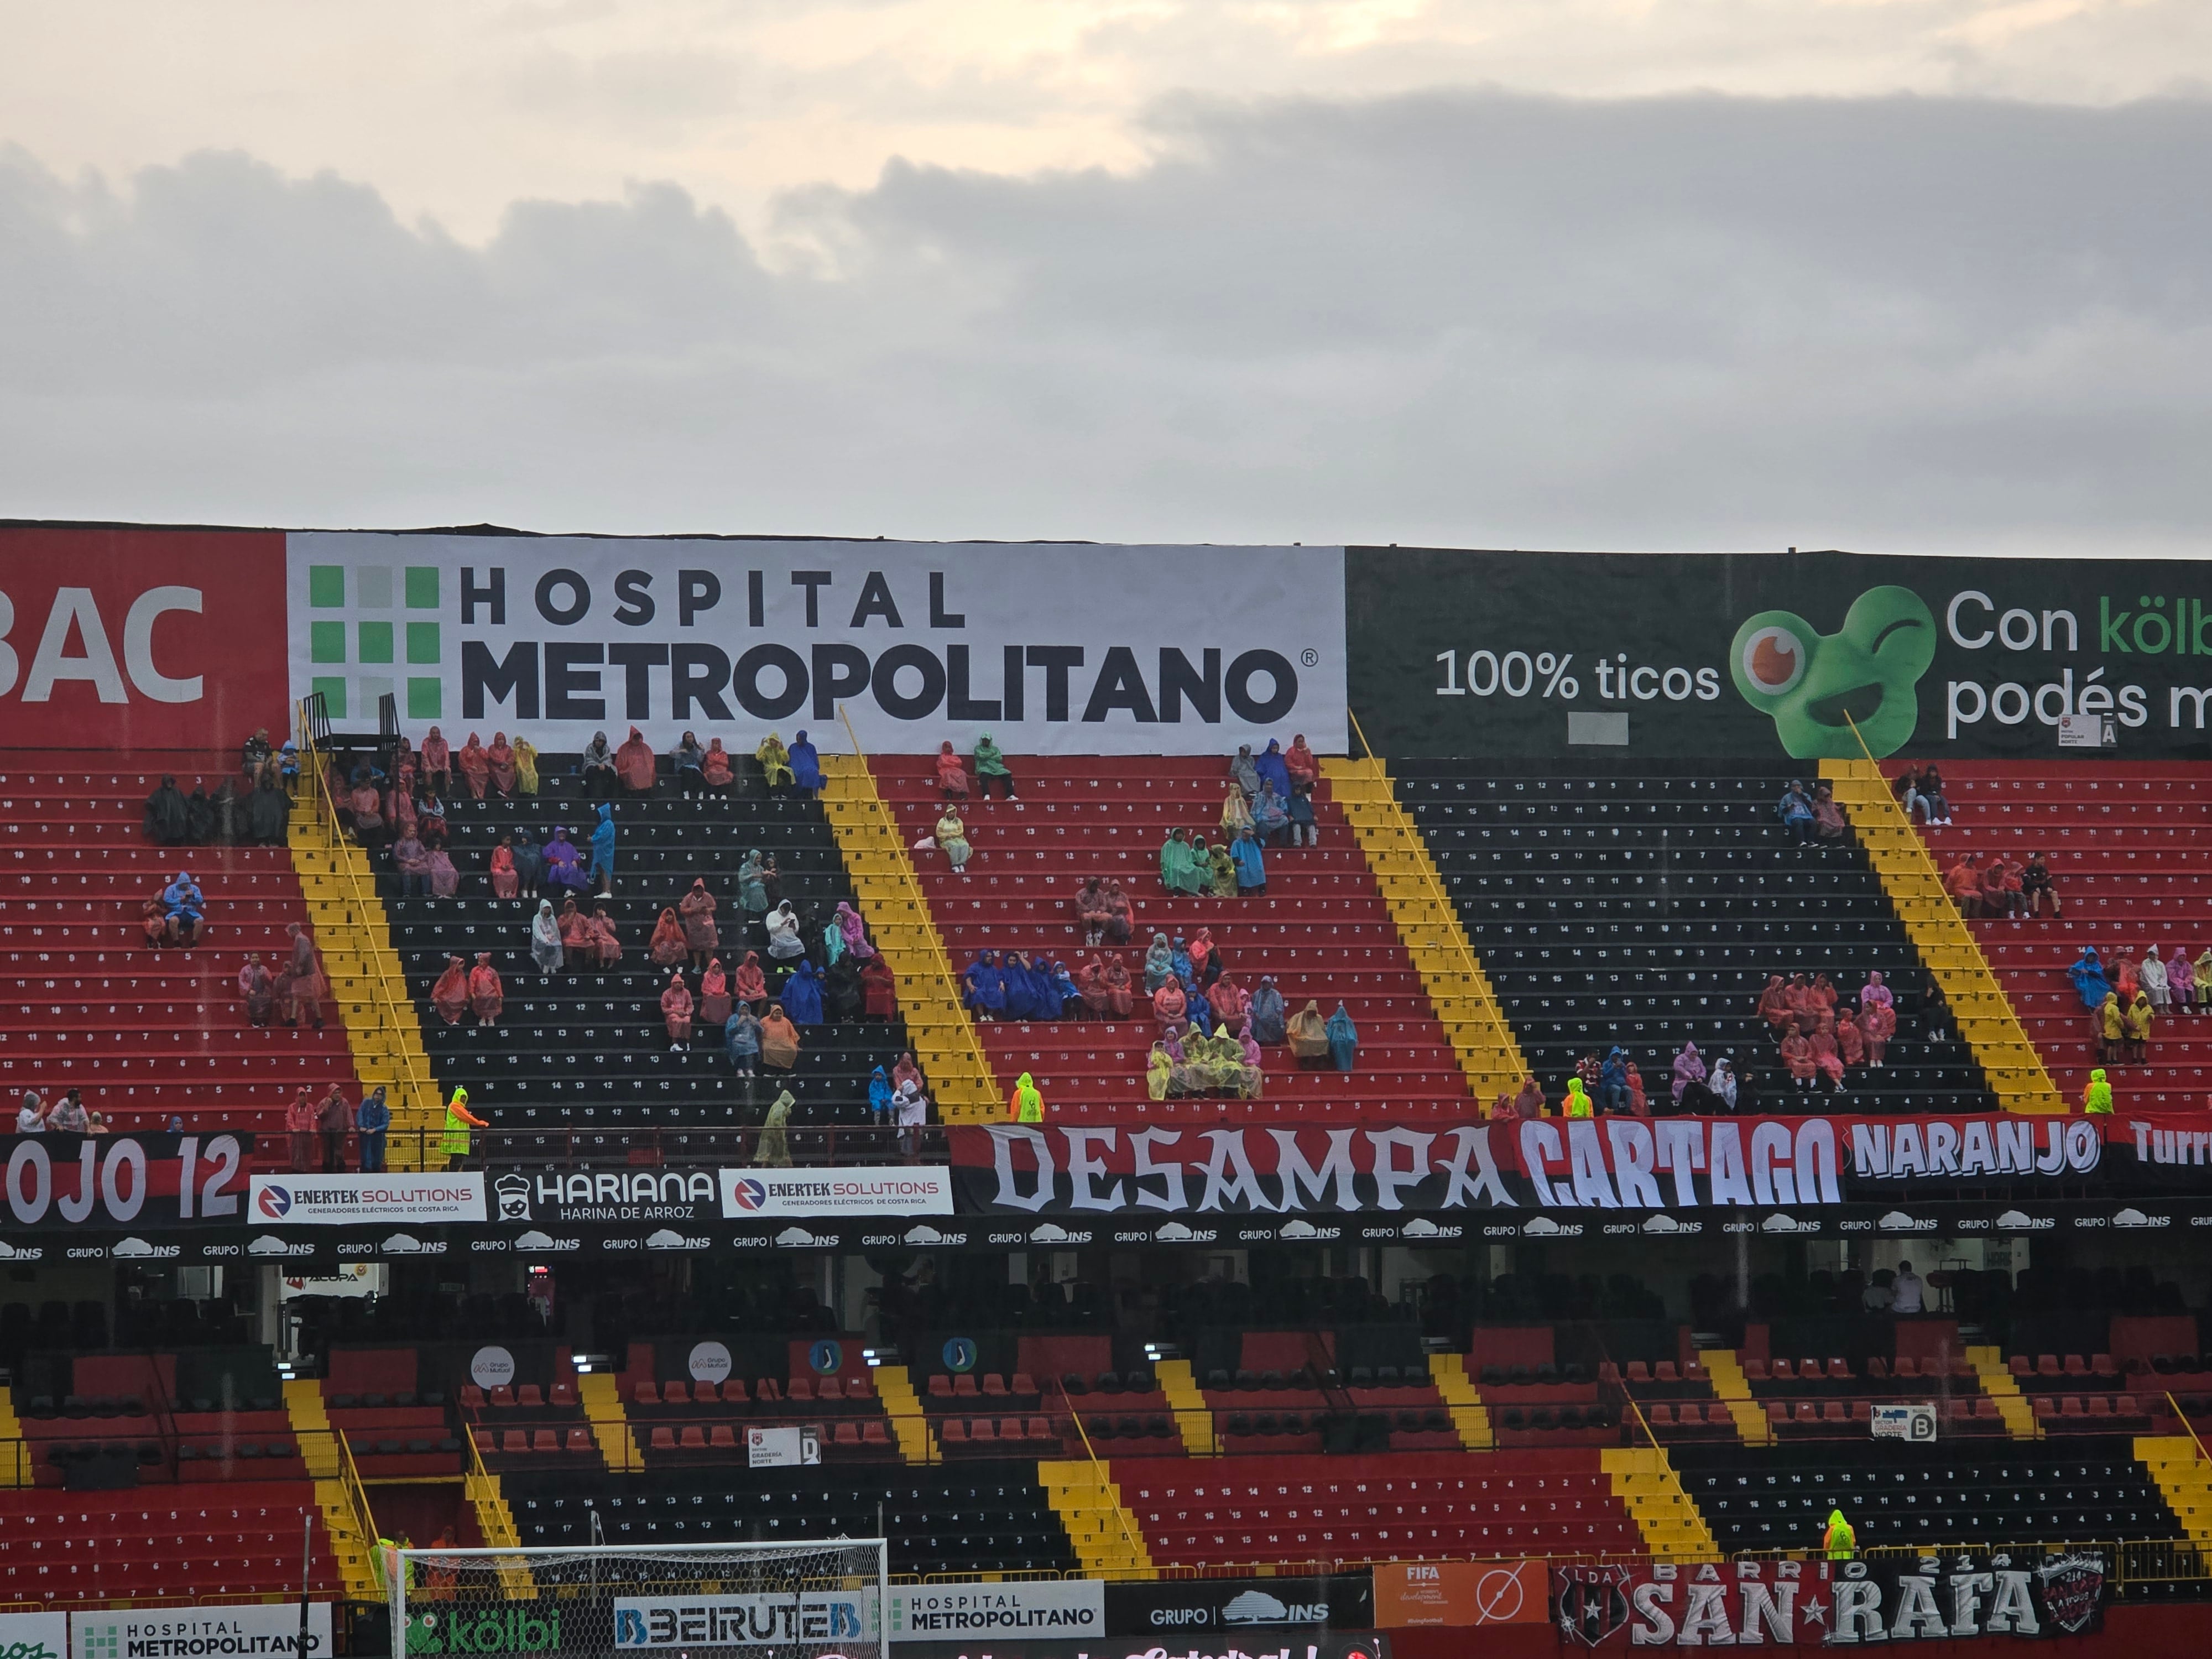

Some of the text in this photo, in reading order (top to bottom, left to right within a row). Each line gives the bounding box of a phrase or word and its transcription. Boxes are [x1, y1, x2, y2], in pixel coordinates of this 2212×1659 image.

[460, 567, 966, 629] HOSPITAL
[1947, 590, 2078, 651] Con
[0, 585, 204, 704] AC
[1436, 649, 1720, 701] 100% ticos
[1947, 666, 2147, 740] podés
[2102, 724, 2117, 743] A
[1850, 1120, 2100, 1179] NARANJO
[979, 1124, 1520, 1213] DESAMPA
[1520, 1118, 1841, 1208] CARTAGO
[178, 1134, 241, 1219] 12
[536, 1172, 714, 1204] HARIANA
[768, 1182, 939, 1198] ENERTEK SOLUTIONS
[294, 1188, 472, 1204] ENERTEK SOLUTIONS
[362, 1205, 404, 1213] ELÉCTRICOS
[561, 1206, 695, 1220] HARINA DE ARROZ
[1603, 1222, 1702, 1234] GRUPO INS
[1723, 1220, 1821, 1233] GRUPO INS
[1840, 1219, 1938, 1230] GRUPO INS
[1958, 1218, 2055, 1229] GRUPO INS
[2074, 1216, 2171, 1227] GRUPO INS
[1114, 1230, 1217, 1241] GRUPO INS
[1239, 1227, 1341, 1240] GRUPO INS
[1362, 1226, 1463, 1238] GRUPO INS
[1483, 1224, 1583, 1235] GRUPO INS
[603, 1237, 711, 1249] GRUPO INS
[733, 1235, 839, 1247] GRUPO INS
[862, 1233, 967, 1245] GRUPO INS
[988, 1232, 1092, 1243] GRUPO INS
[67, 1245, 180, 1257] GRUPO INS
[203, 1244, 315, 1255] GRUPO INS
[337, 1241, 447, 1254] GRUPO INS
[471, 1239, 580, 1251] GRUPO INS
[15, 1248, 43, 1259] INS
[1915, 1418, 1929, 1436] B
[1406, 1566, 1440, 1580] FIFA
[1653, 1553, 2012, 1581] BARRIO 214
[1574, 1569, 1613, 1583] LDA
[2065, 1571, 2081, 1583] 214
[911, 1594, 1021, 1610] HOSPITAL
[1632, 1581, 1799, 1646] SAN
[1832, 1571, 2041, 1643] RAFA
[1150, 1603, 1329, 1625] GRUPO INS
[127, 1621, 242, 1638] HOSPITAL
[449, 1609, 560, 1653] kölbi
